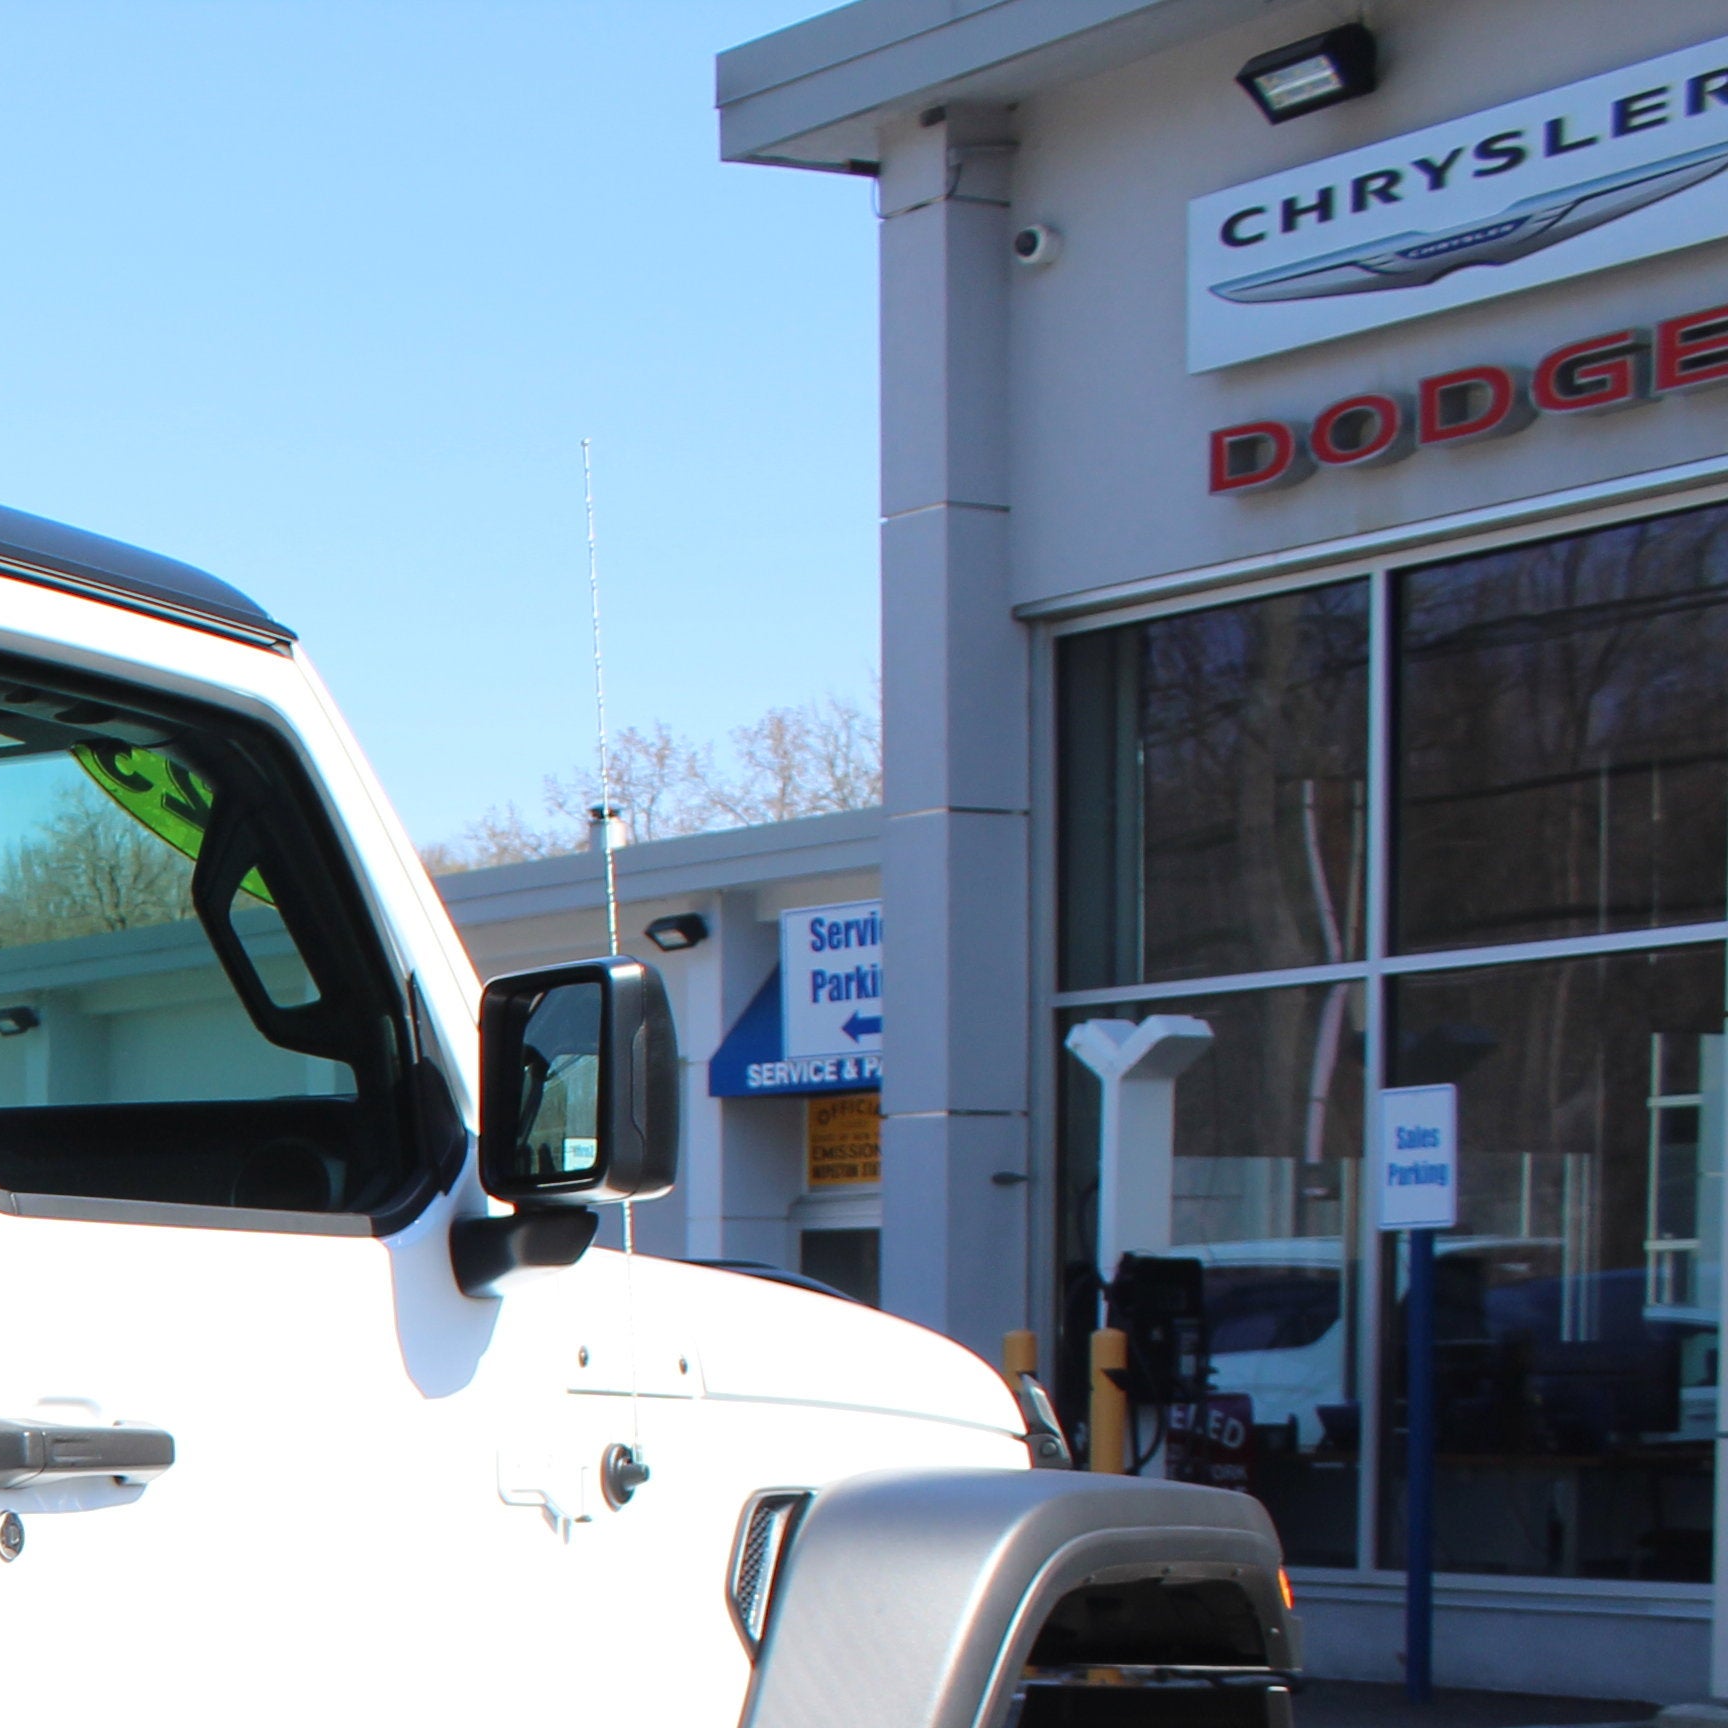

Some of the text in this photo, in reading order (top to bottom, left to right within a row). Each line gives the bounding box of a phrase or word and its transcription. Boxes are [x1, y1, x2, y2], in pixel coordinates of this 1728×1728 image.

[1219, 68, 1728, 248] CHRYSLER
[1208, 303, 1728, 496] DODGE
[809, 909, 882, 952] Servi
[810, 963, 882, 1004] Parki
[746, 1058, 838, 1089] SERVICE
[1394, 1124, 1441, 1150] Sales
[1386, 1160, 1451, 1187] Parking
